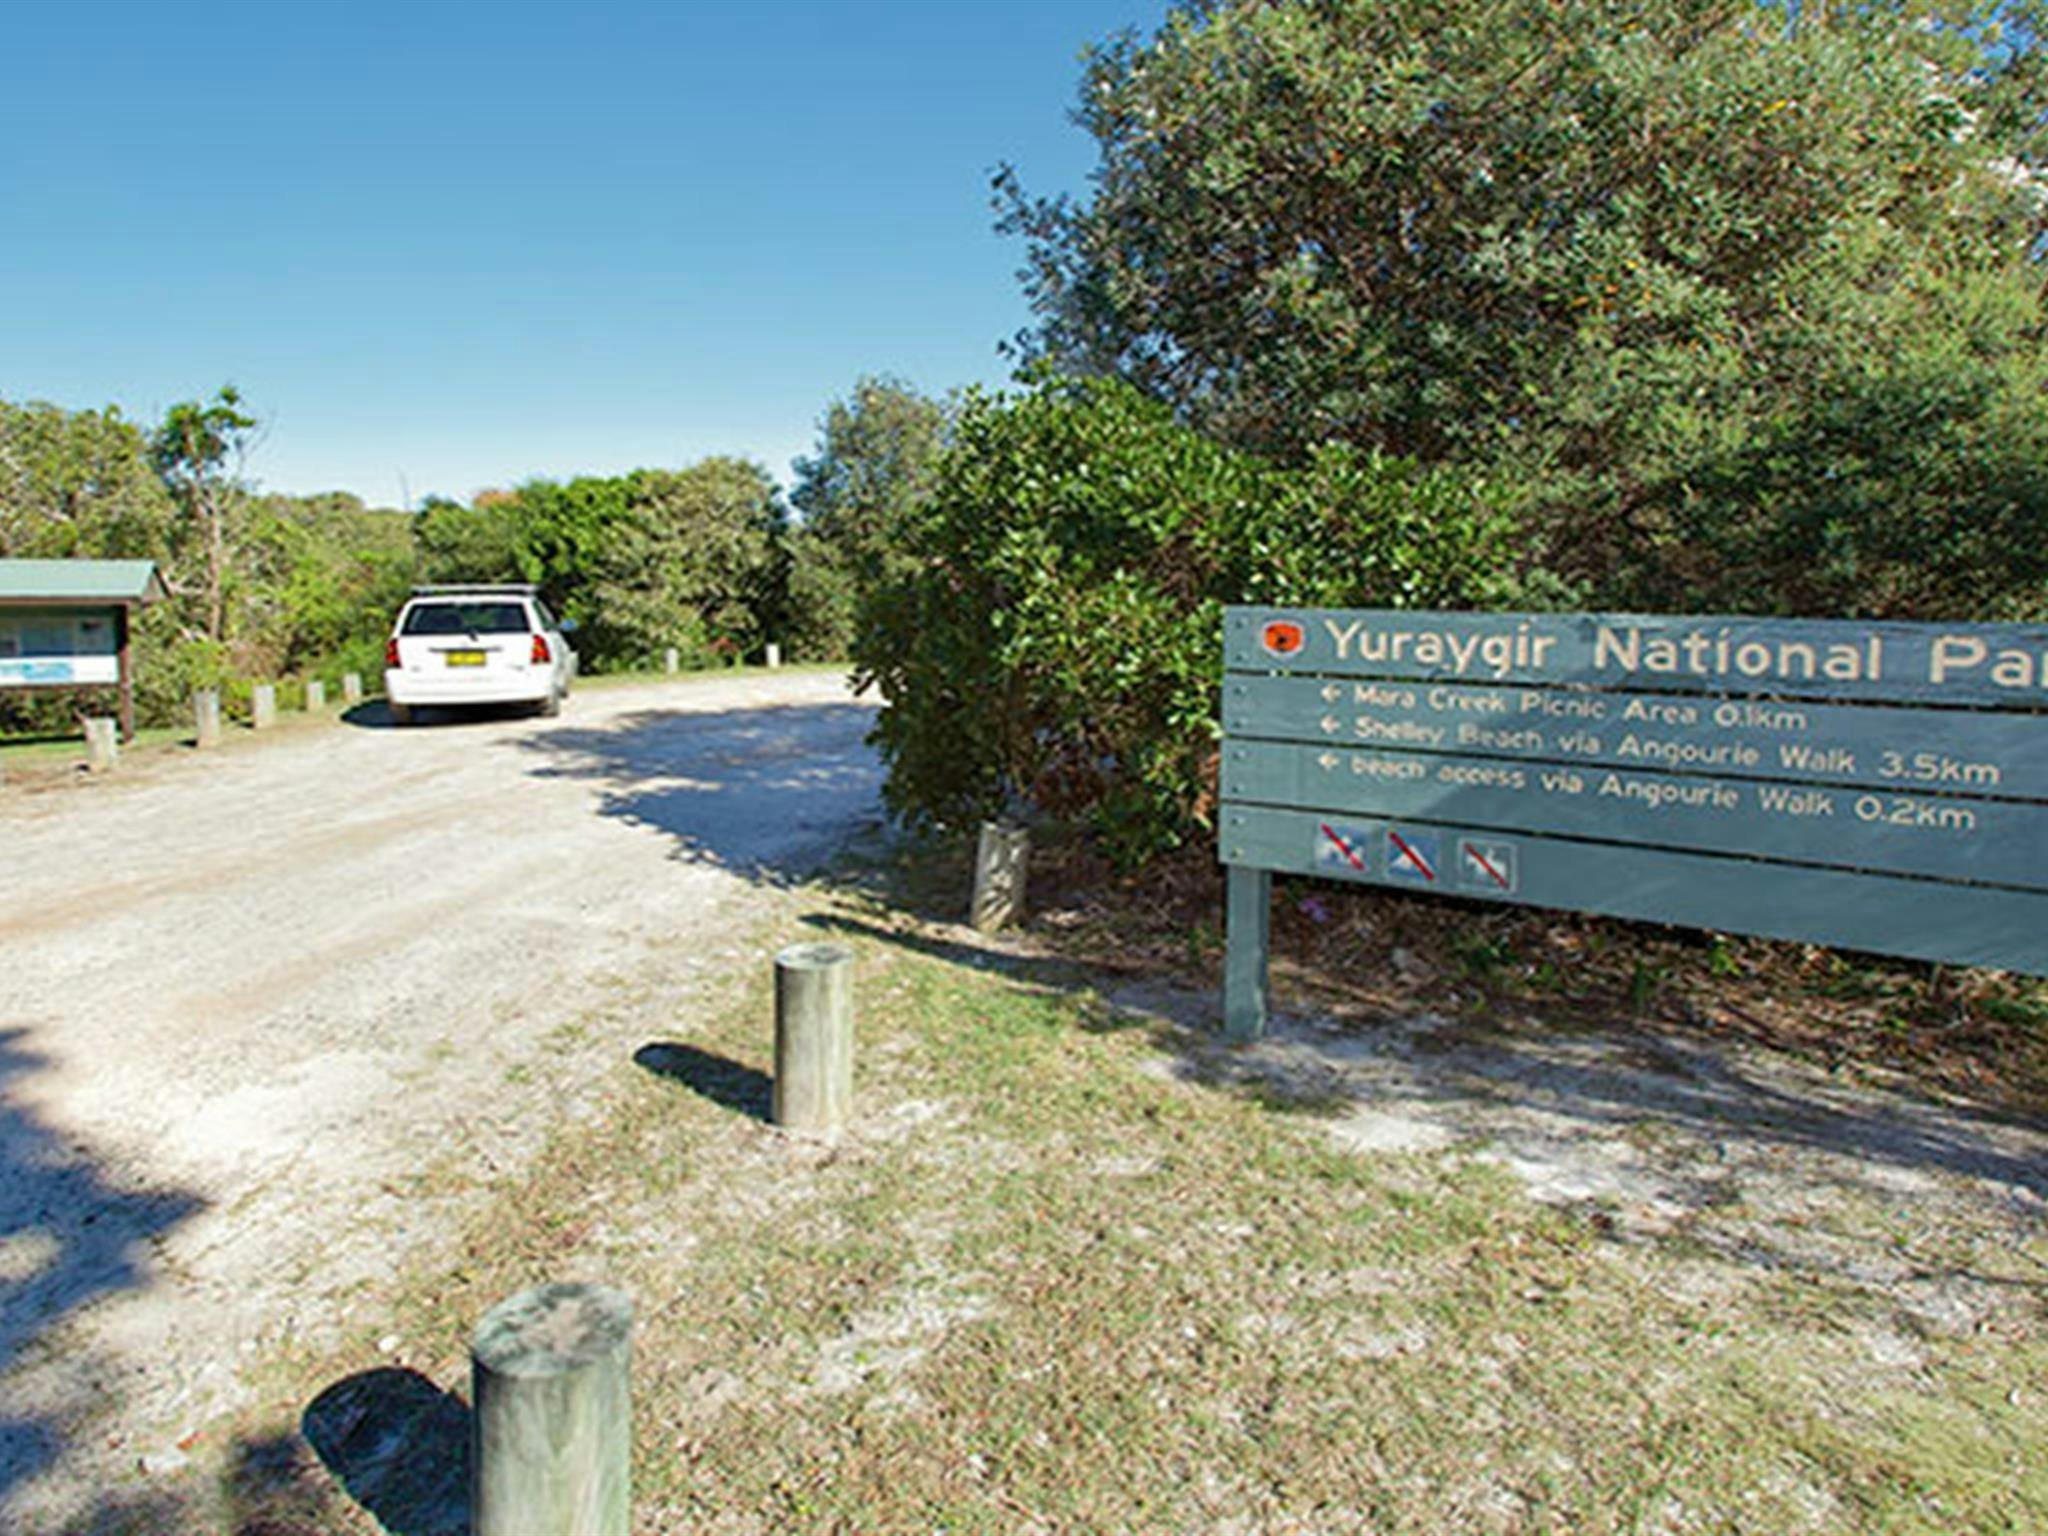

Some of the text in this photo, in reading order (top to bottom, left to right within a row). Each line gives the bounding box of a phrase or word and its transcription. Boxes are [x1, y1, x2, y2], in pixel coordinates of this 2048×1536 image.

[1324, 619, 2048, 687] Yuraygir National Pa
[1428, 689, 1507, 713] Creek
[1520, 692, 1606, 719] Picnic
[1622, 698, 1697, 725] Area
[1354, 716, 2000, 785] Shelley Beach via Angourie Walk 3.5km
[1351, 755, 1976, 831] beach access via Angourie Walk 0.2km
